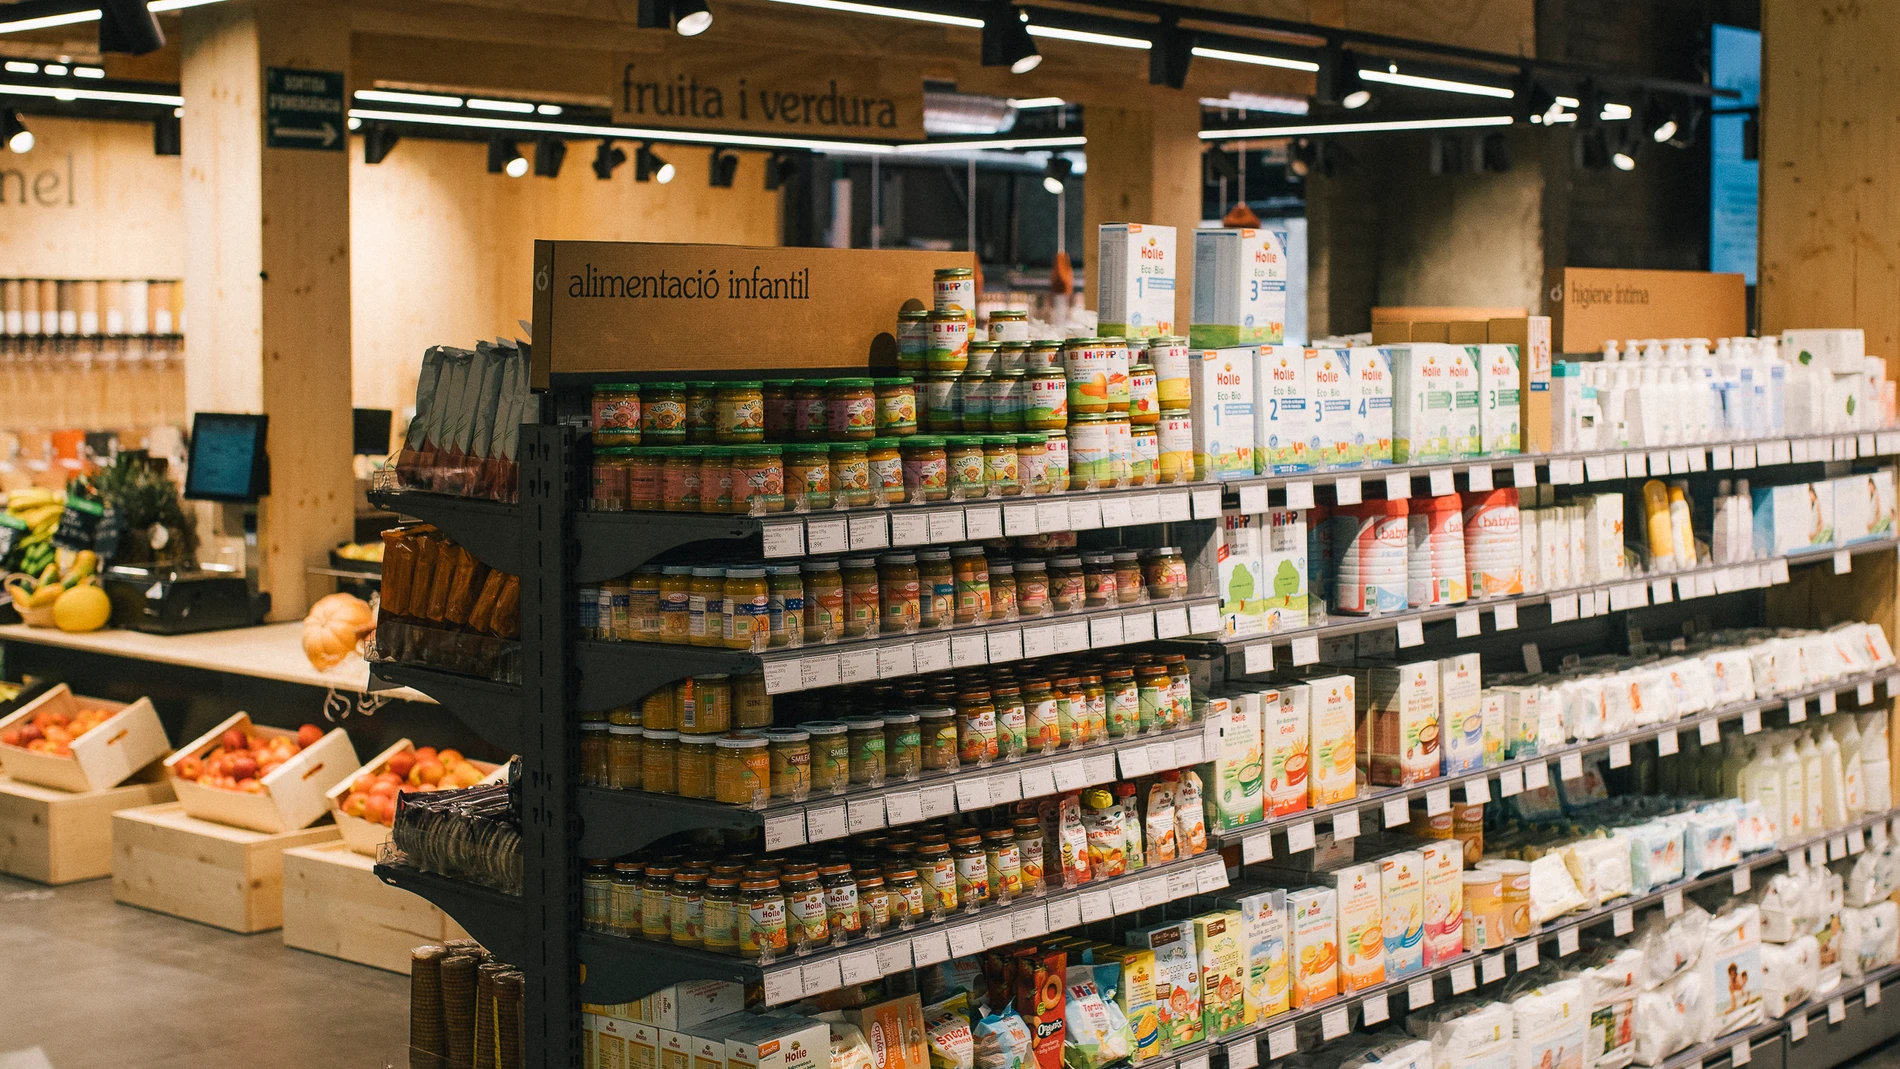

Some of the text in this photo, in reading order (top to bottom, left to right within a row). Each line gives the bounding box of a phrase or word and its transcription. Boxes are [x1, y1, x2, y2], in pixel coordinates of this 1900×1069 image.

[622, 63, 899, 130] fruita i verdura
[1140, 246, 1164, 260] Holle
[1255, 251, 1277, 264] Holle
[568, 263, 809, 300] alimentació infantil
[1136, 276, 1143, 298] 1
[1250, 280, 1258, 301] 3
[1571, 282, 1612, 308] higiene
[1273, 367, 1295, 381] Holle
[1316, 370, 1339, 383] Holle
[1361, 369, 1382, 381] Holle
[1421, 366, 1442, 377] Holle
[1449, 366, 1469, 377] Holle
[1491, 364, 1511, 376] Holle
[1216, 372, 1241, 386] Holle
[1357, 397, 1366, 419] 4
[1489, 390, 1496, 410] 3
[1213, 403, 1220, 426] 1
[1269, 398, 1278, 421] 2
[1314, 400, 1322, 422] 3
[1226, 514, 1251, 531] HiPP
[1272, 511, 1298, 527] HiPP
[830, 894, 850, 904] Holle
[762, 909, 781, 919] Holle
[1211, 950, 1239, 967] BIOCOOKIES
[1160, 960, 1192, 977] BIOCOOKIES
[935, 1025, 970, 1046] Snack
[875, 1024, 886, 1065] babybio
[785, 1048, 807, 1063] Holle
